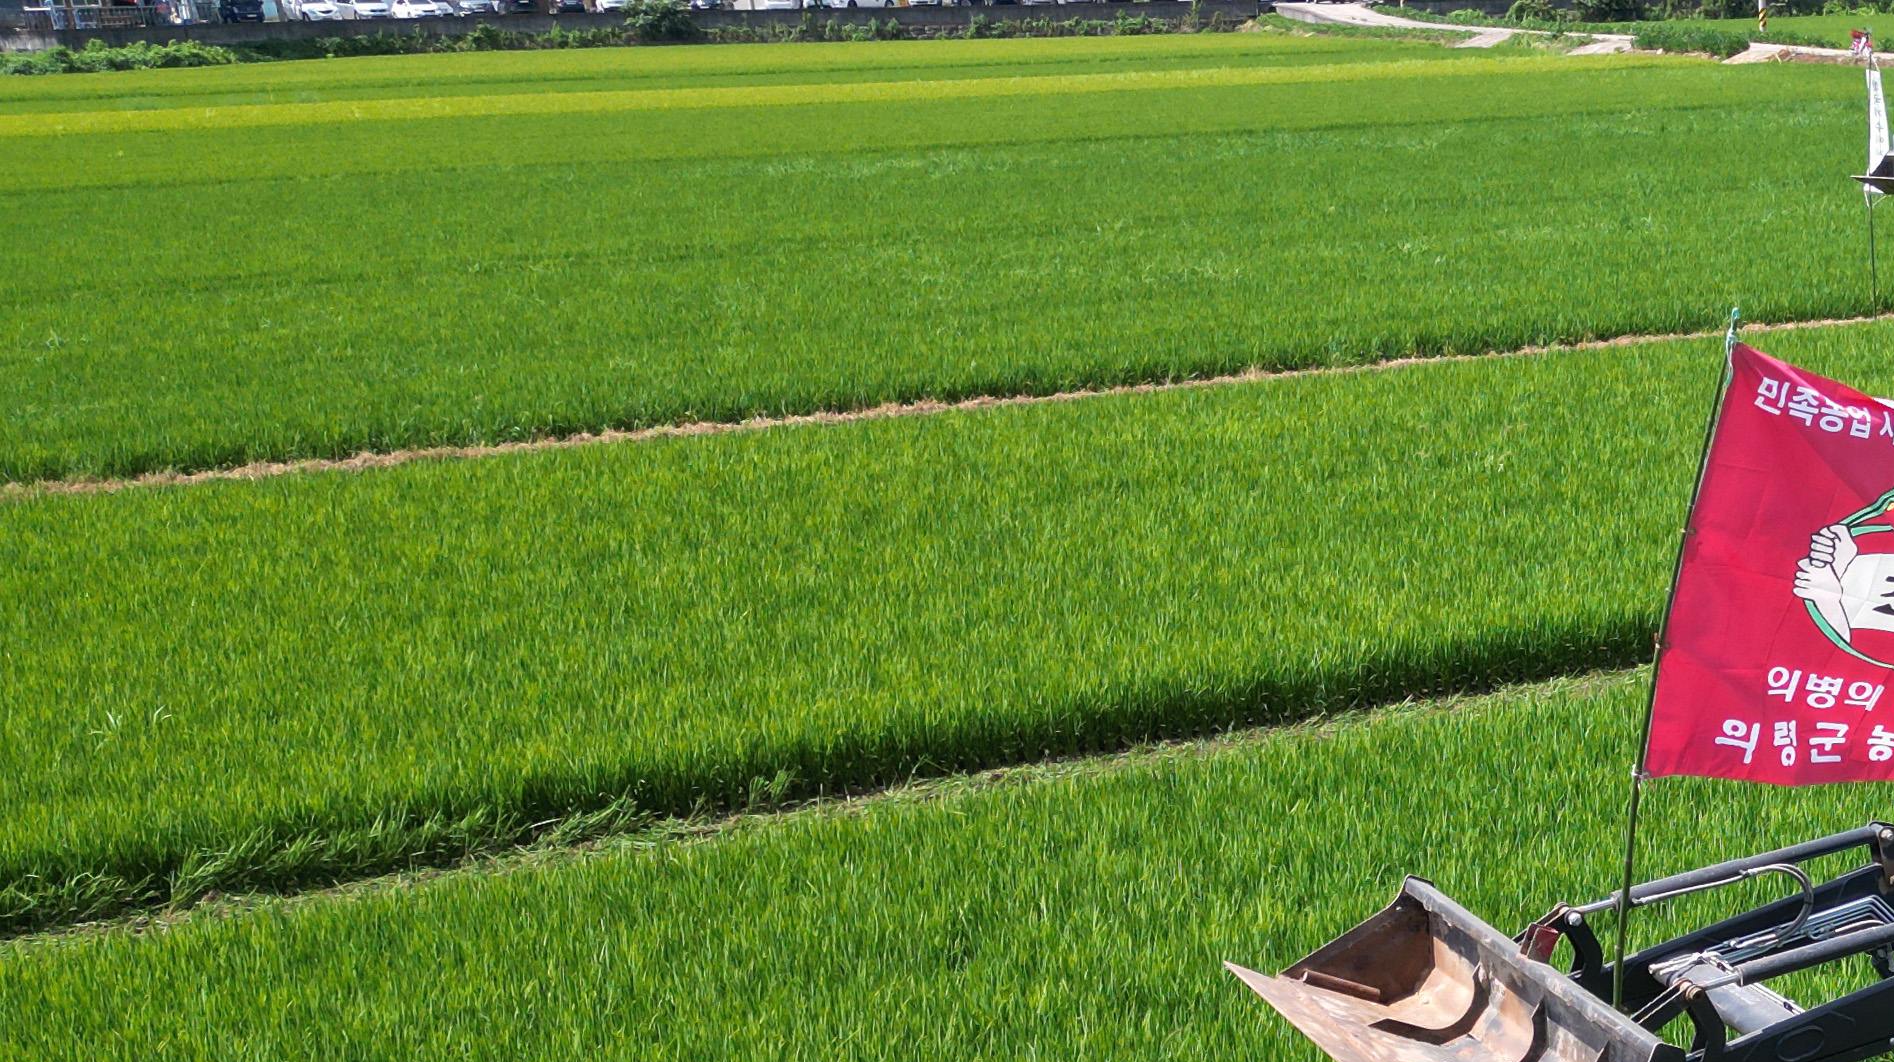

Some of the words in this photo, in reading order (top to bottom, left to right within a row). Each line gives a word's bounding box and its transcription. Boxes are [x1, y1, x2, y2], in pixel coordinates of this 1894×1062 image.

[1753, 377, 1871, 440] 민족농업
[1767, 666, 1885, 712] 의병의
[1714, 718, 1850, 767] 의령군
